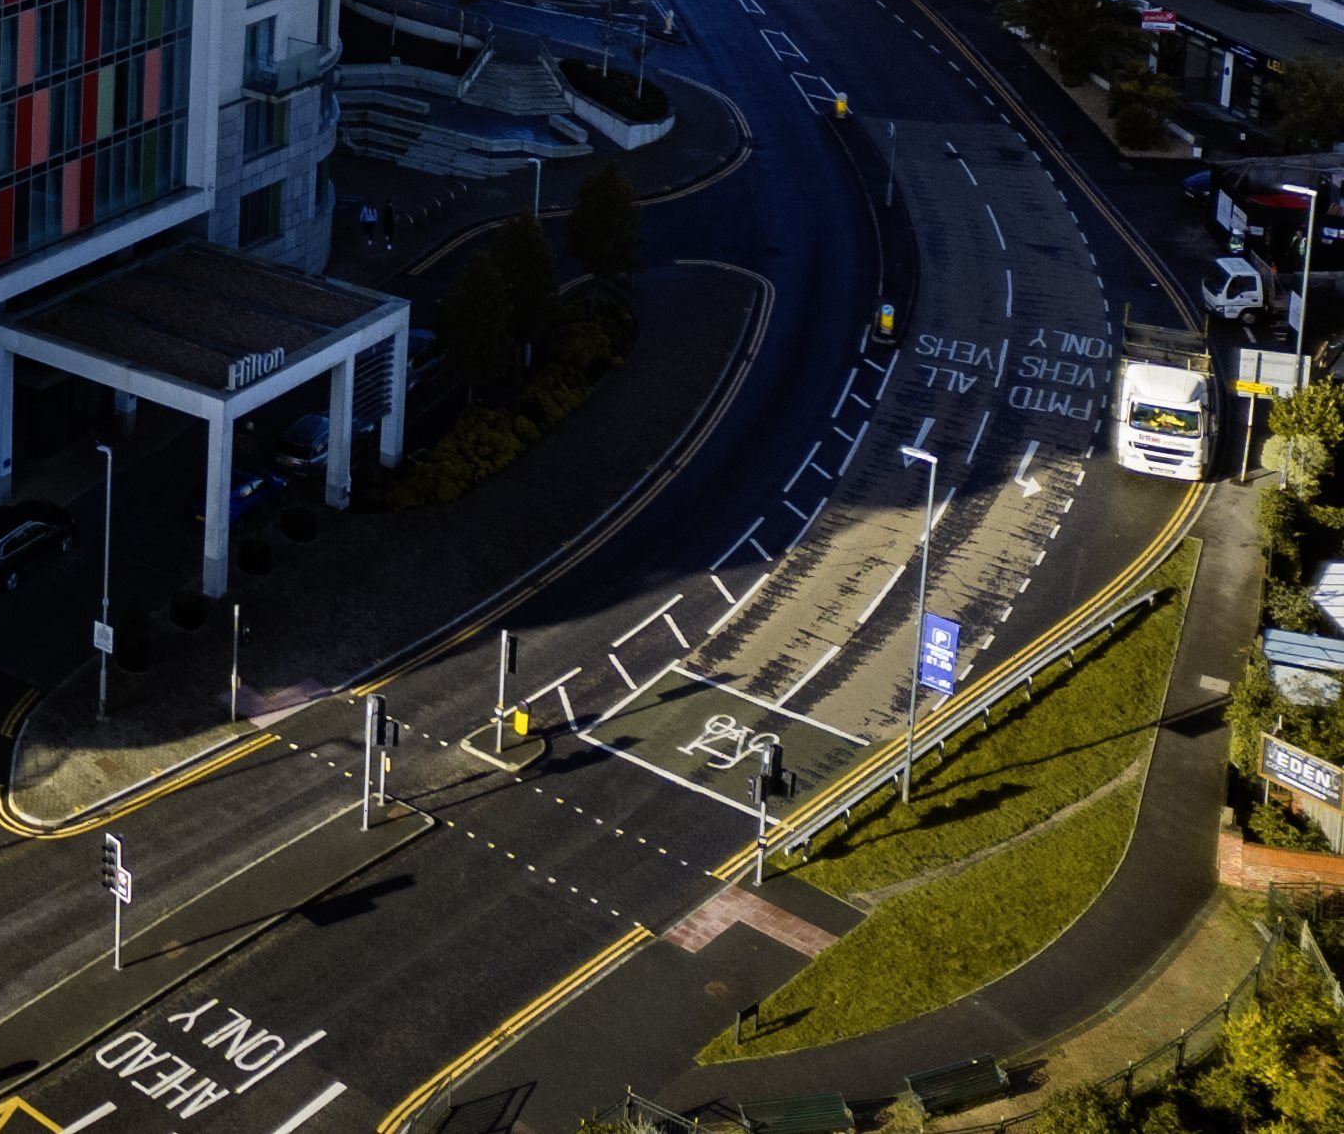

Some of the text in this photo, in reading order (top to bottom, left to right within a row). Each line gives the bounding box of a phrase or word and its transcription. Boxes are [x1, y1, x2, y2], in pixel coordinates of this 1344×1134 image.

[915, 334, 993, 370] VEHS
[1028, 328, 1105, 358] ONLY
[225, 346, 285, 391] Hilton
[920, 364, 978, 394] ALL
[1018, 356, 1095, 388] VEHS
[1009, 386, 1093, 421] PMTD
[934, 630, 948, 644] P
[1277, 751, 1331, 789] EDEN
[167, 998, 286, 1071] ONLY
[95, 1031, 230, 1120] AHEAD
